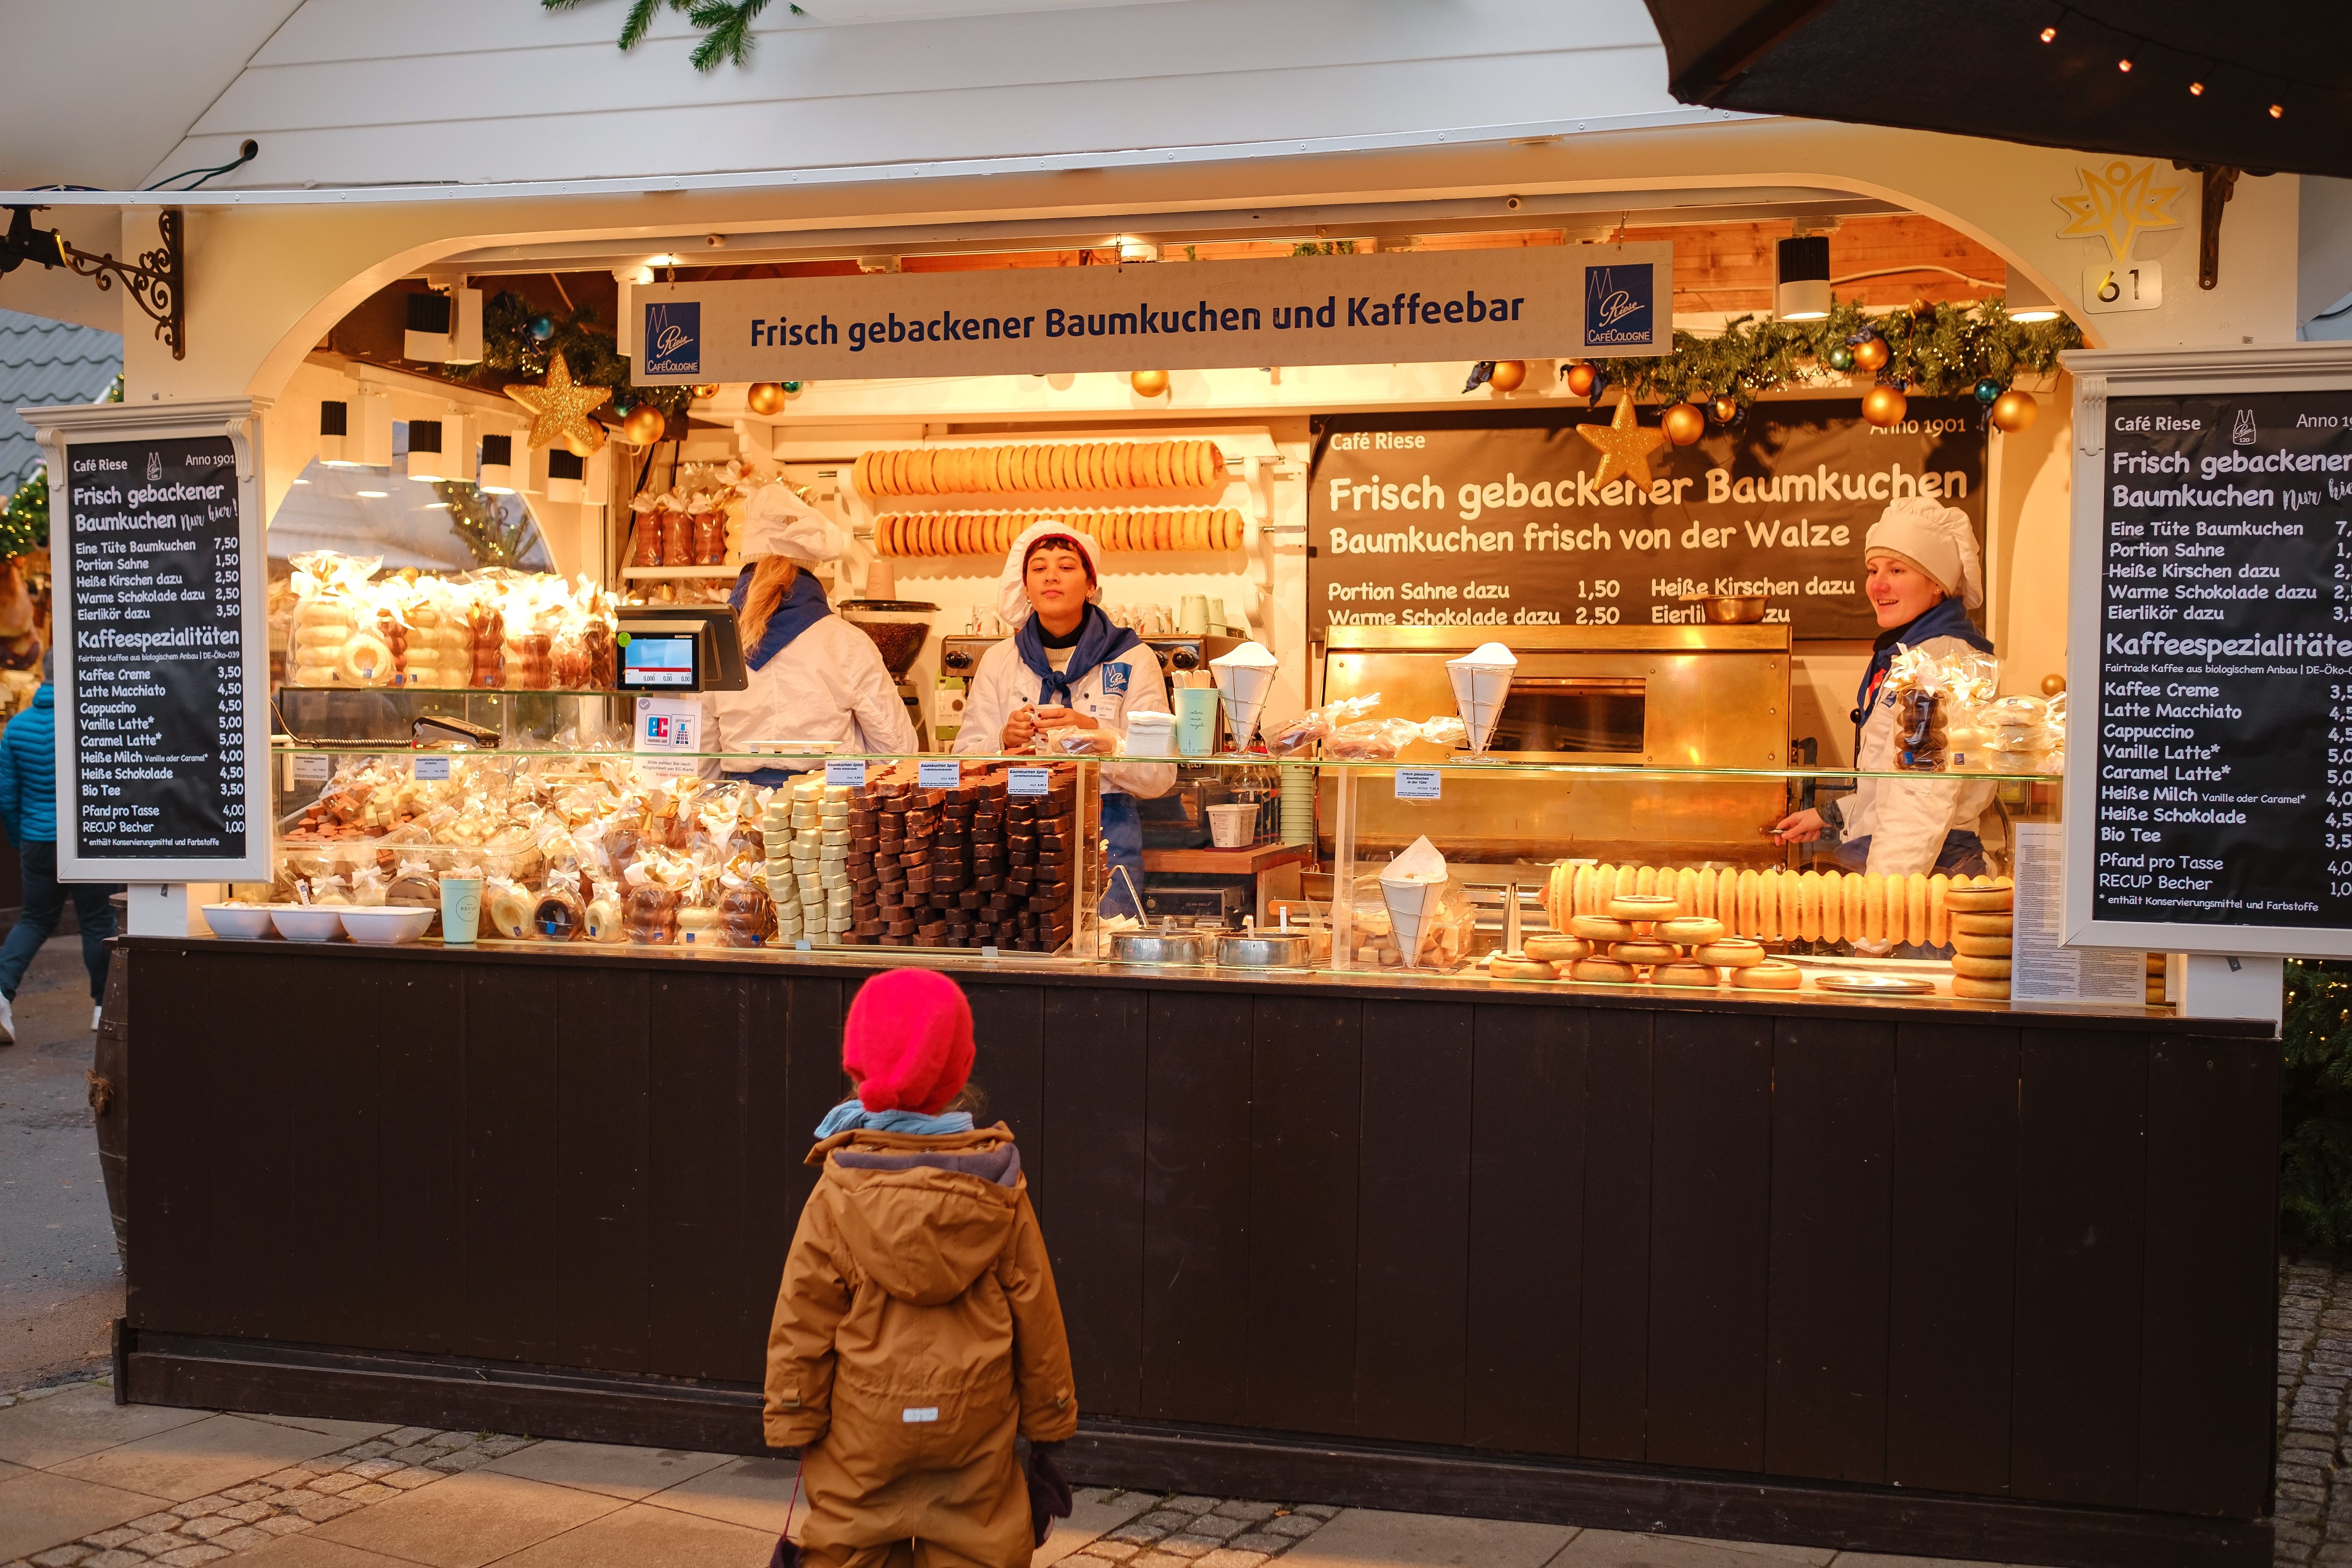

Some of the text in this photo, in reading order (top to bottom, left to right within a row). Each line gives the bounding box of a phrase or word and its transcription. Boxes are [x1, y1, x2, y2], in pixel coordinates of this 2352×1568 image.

[2097, 269, 2140, 303] 61
[1599, 291, 1645, 327] Riese
[751, 290, 1525, 352] Frisch gebackener Baumkuchen und Kaffeebar
[656, 325, 693, 358] Riese
[1923, 418, 1966, 438] 1901
[2115, 416, 2201, 431] Café Riese
[2296, 413, 2338, 428] Anno
[1330, 432, 1426, 450] Café Riese
[73, 458, 128, 472] Café Riese
[185, 454, 235, 467] Anno 1901
[2113, 449, 2352, 480] Frisch gebackener
[74, 482, 225, 509] Frisch gebackener
[1329, 462, 1967, 520] Frisch gebackener Baumkuchen
[2112, 484, 2274, 507] Baumkuchen
[75, 510, 176, 532] Baumkuchen
[208, 498, 238, 522] hier!
[1329, 518, 1850, 554] Baumkuchen frisch von der Walze
[2111, 521, 2303, 536] Eine Tüte Baumkuchen
[75, 536, 238, 554] Eine Tüte Baumkuchen 7,50
[2110, 542, 2225, 557] Portion Sahne
[76, 553, 239, 571] Portion Sahne 1,50
[2107, 563, 2280, 578] Heiße Kirschen dazu
[77, 570, 239, 588] Heiße Kirschen dazu 2,50
[1651, 575, 1856, 597] Heiße Kirschen dazu
[77, 587, 240, 604] Warme Schokolade dazu 2,50
[1328, 580, 1620, 601] Portion Sahne dazu 1,50
[2108, 584, 2317, 600] Warme Schokolade dazu
[78, 604, 240, 620] Eierlikör dazu 3,50
[1328, 606, 1620, 625] Warme Schokolade dazu 2,50
[2108, 605, 2224, 620] Eierlikör dazu
[78, 625, 239, 653] Kaffeespezialitäten
[2107, 631, 2352, 663] Kaffeespezialitäte
[2105, 663, 2149, 672] Fairtrade
[2151, 663, 2184, 673] Kaffee
[2205, 664, 2264, 676] biologischem
[2266, 665, 2298, 674] Anbau
[2105, 681, 2219, 697] Kaffee Creme
[2104, 702, 2242, 719] Latte Macchiato
[2104, 723, 2194, 743] Cappuccino
[2103, 744, 2159, 759] Vanille
[2102, 765, 2168, 780] Caramel
[2102, 785, 2149, 800] Heiße
[2153, 786, 2197, 802] Milch
[2202, 793, 2234, 802] Vanille
[2236, 794, 2259, 802] oder
[2101, 806, 2246, 824] Heiße Schokolade
[2101, 826, 2161, 842] Bio Tee
[2099, 852, 2223, 872] Pfand pro Tasse
[2099, 873, 2213, 890] RECUP Becher
[2108, 895, 2318, 911] enthält Konservierungsmittel und Farbstoffe
